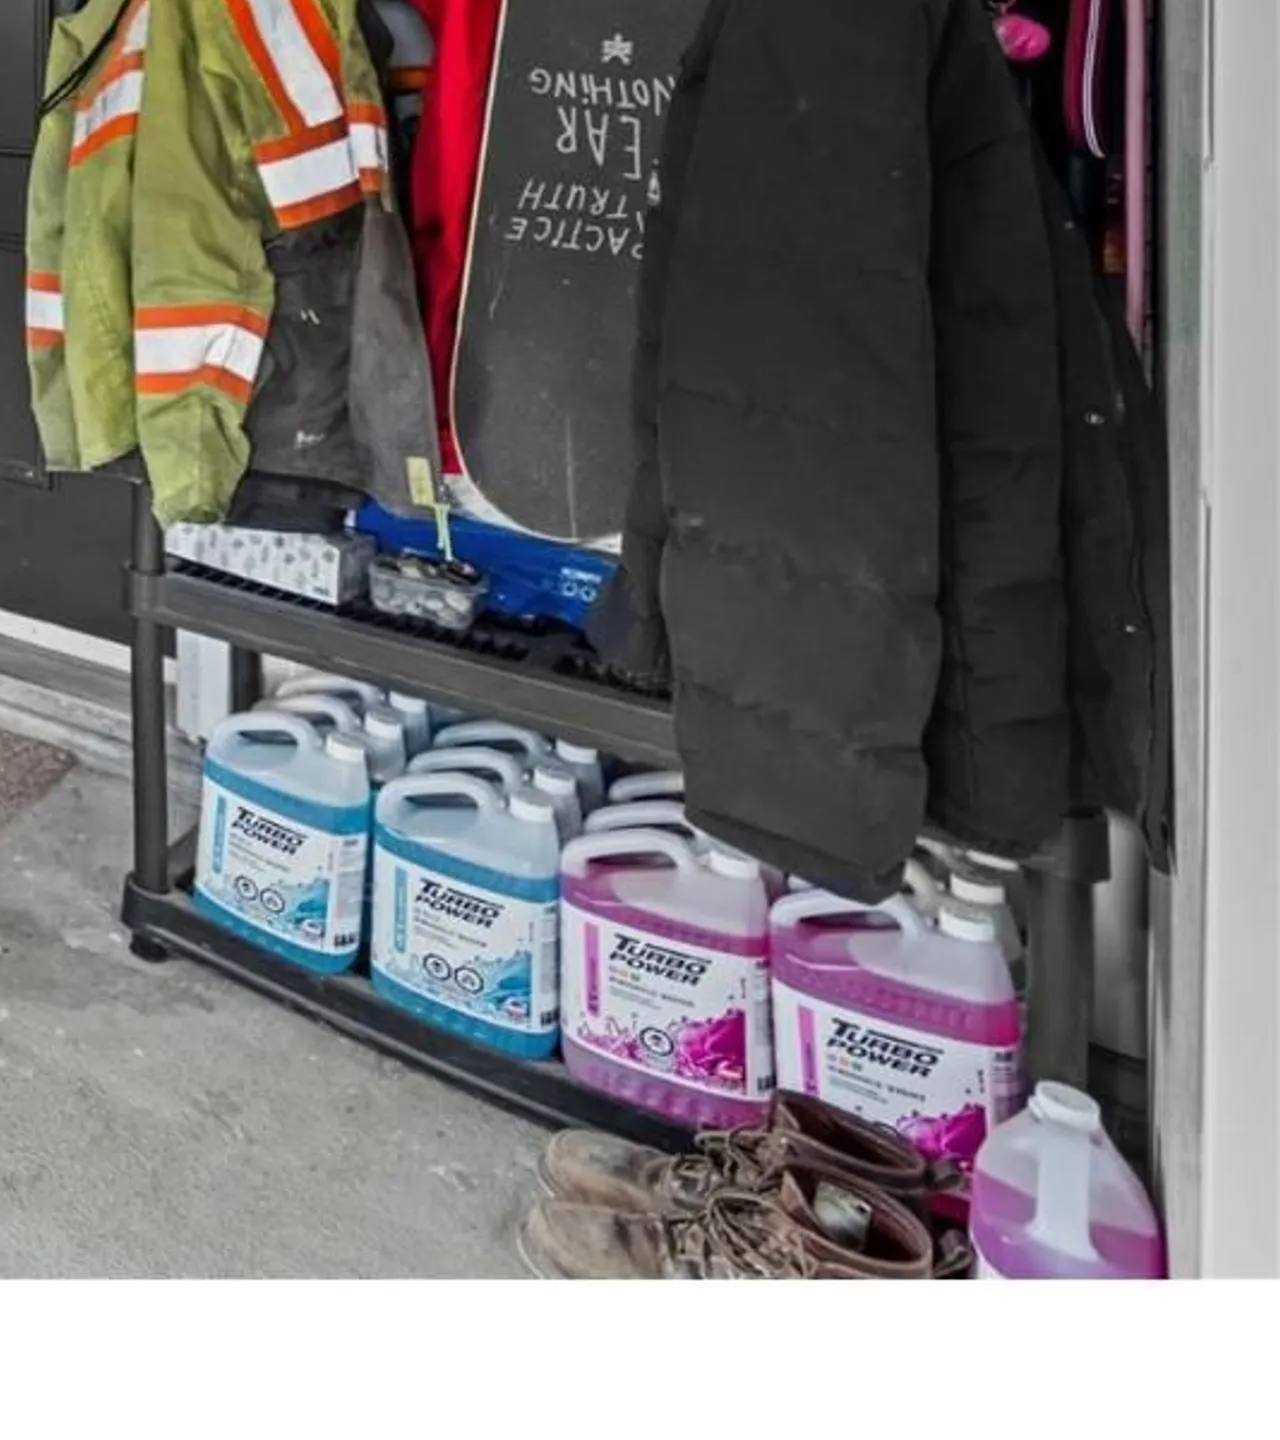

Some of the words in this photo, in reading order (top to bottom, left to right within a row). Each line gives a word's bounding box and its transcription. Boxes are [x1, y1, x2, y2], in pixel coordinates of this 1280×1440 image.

[516, 178, 629, 220] TRUTH
[231, 822, 298, 856] POWER
[236, 806, 308, 849] TURBO
[414, 895, 495, 929] POWER
[419, 878, 506, 919] TURBO
[608, 951, 703, 986] POWER
[613, 933, 713, 975] TURBO
[826, 1038, 933, 1079] POWER
[830, 1018, 944, 1067] TURBO
